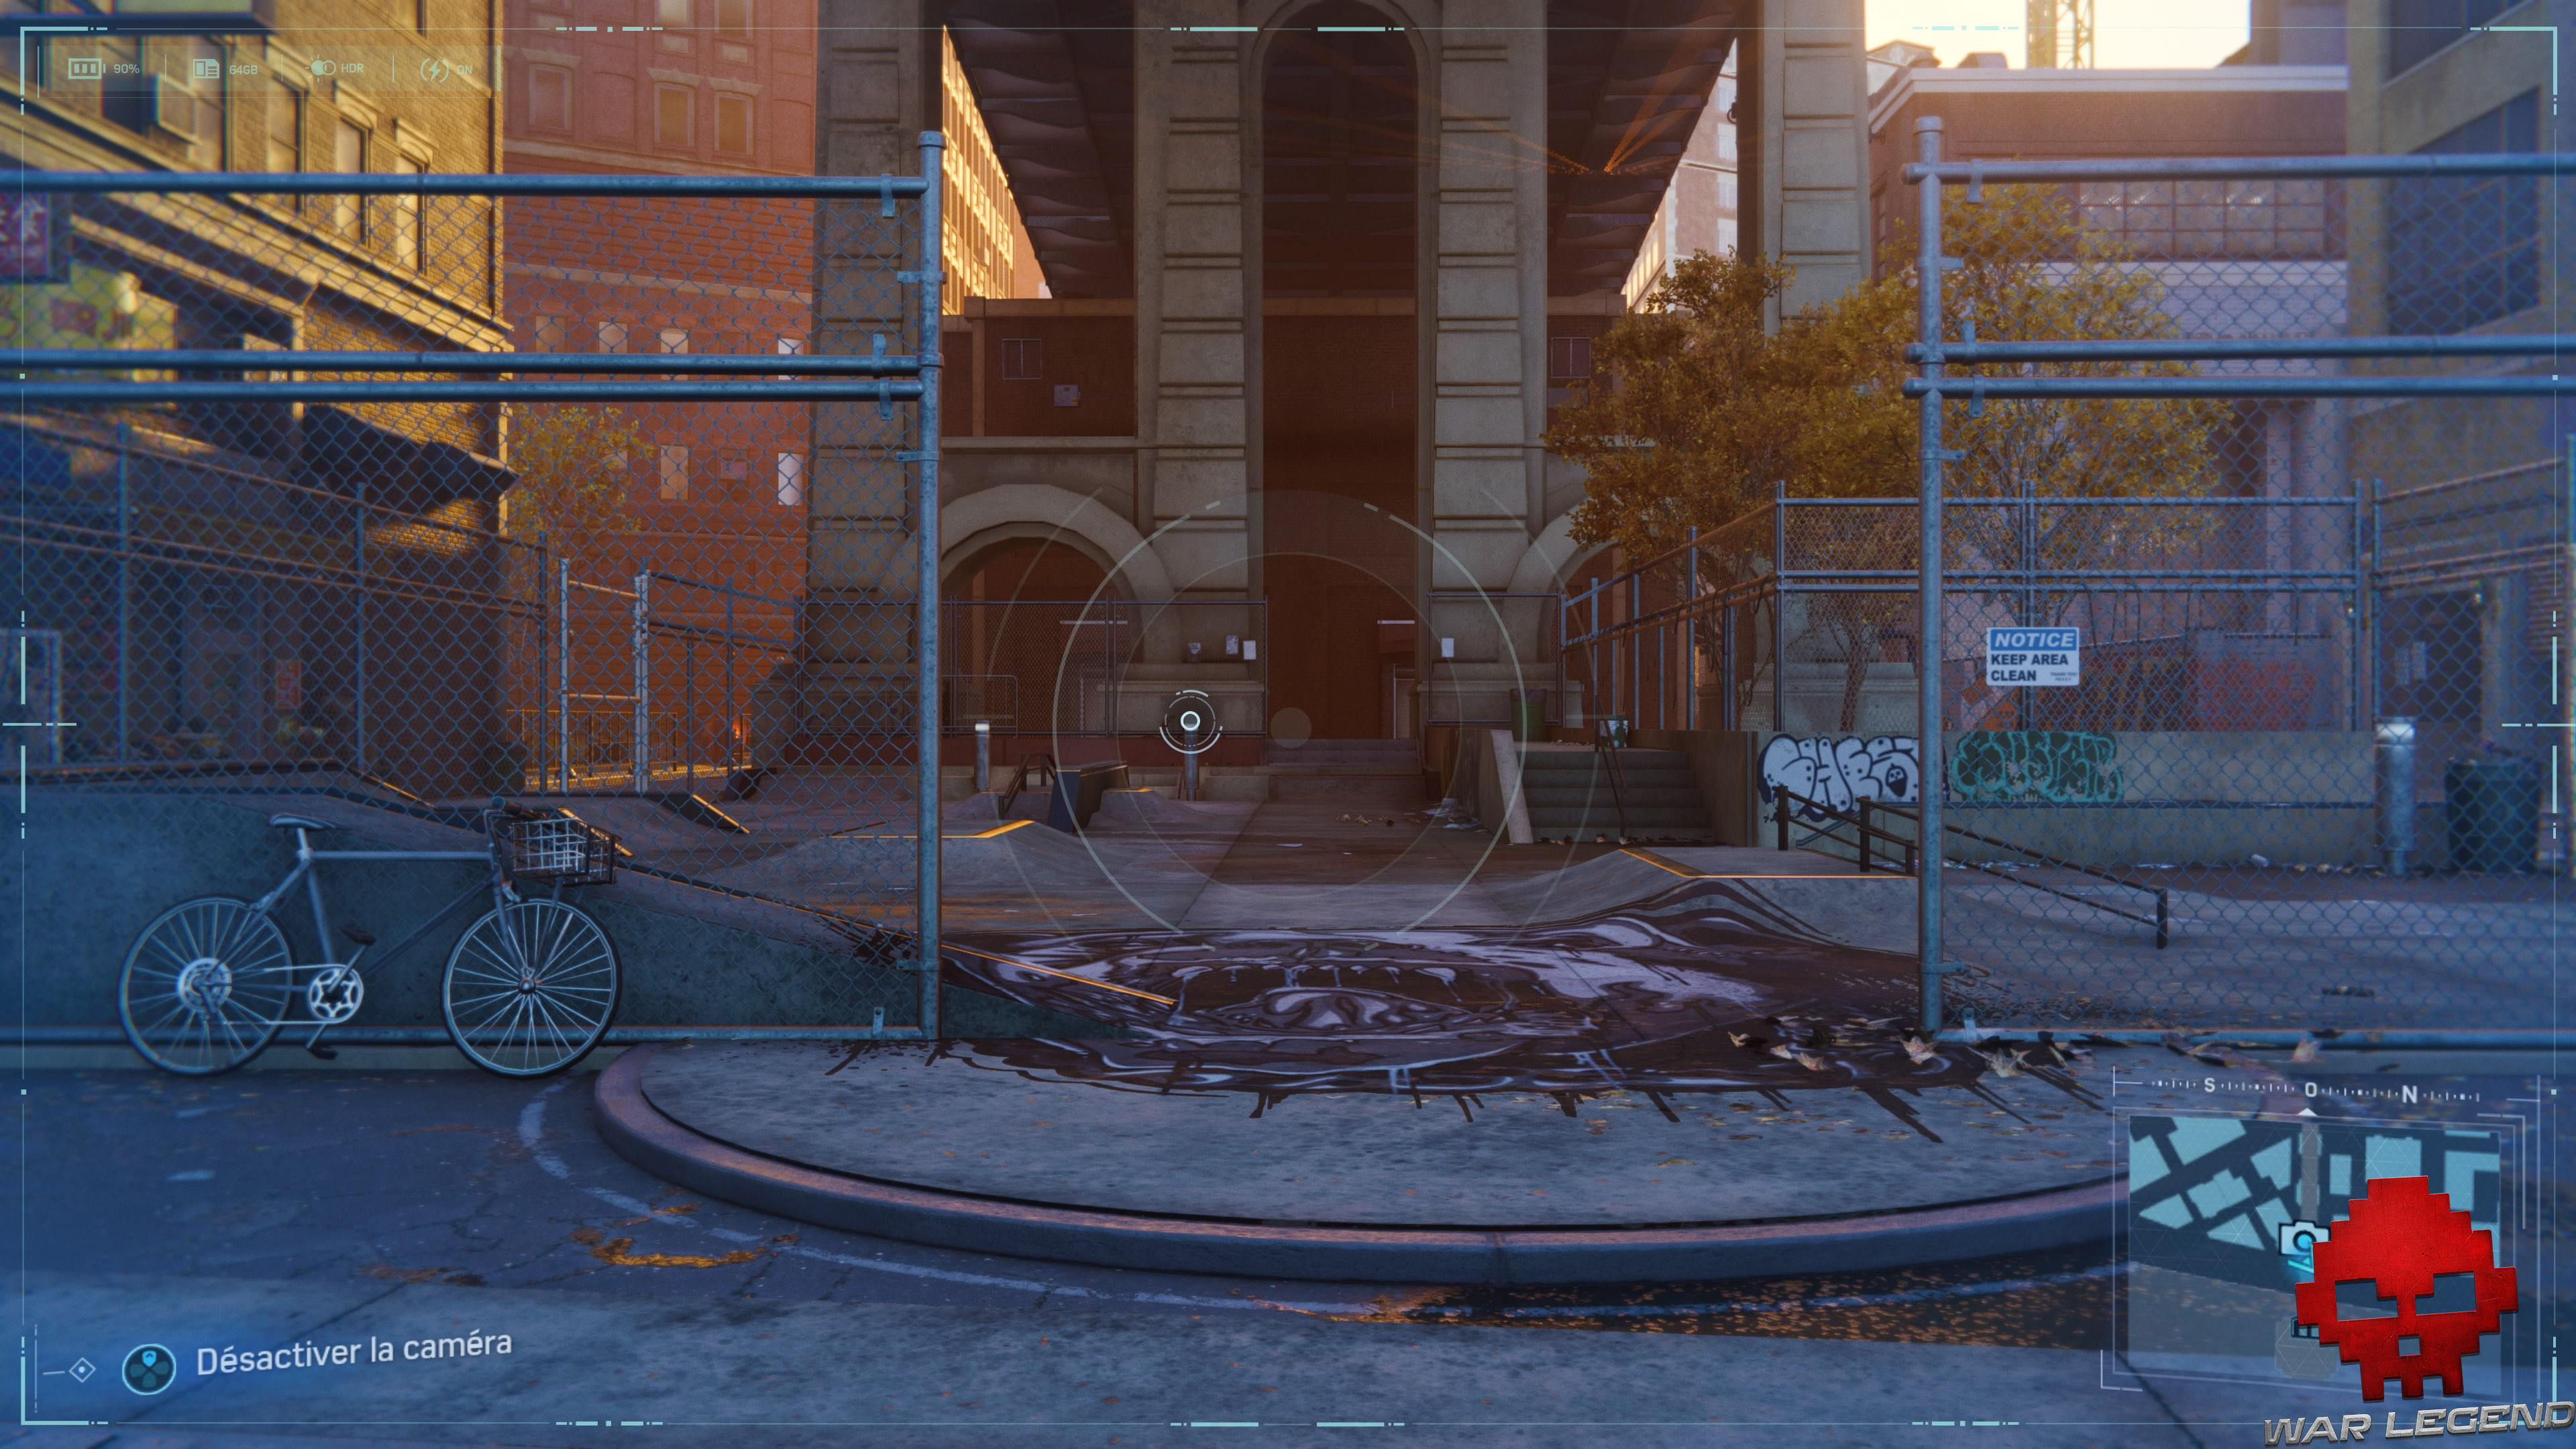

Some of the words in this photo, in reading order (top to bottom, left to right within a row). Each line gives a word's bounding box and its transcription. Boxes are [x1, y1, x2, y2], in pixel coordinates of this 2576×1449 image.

[1995, 633, 2074, 647] NOTICE
[1991, 654, 2027, 665] KEEP
[2031, 654, 2068, 665] AREA
[1991, 670, 2037, 682] CLEAN
